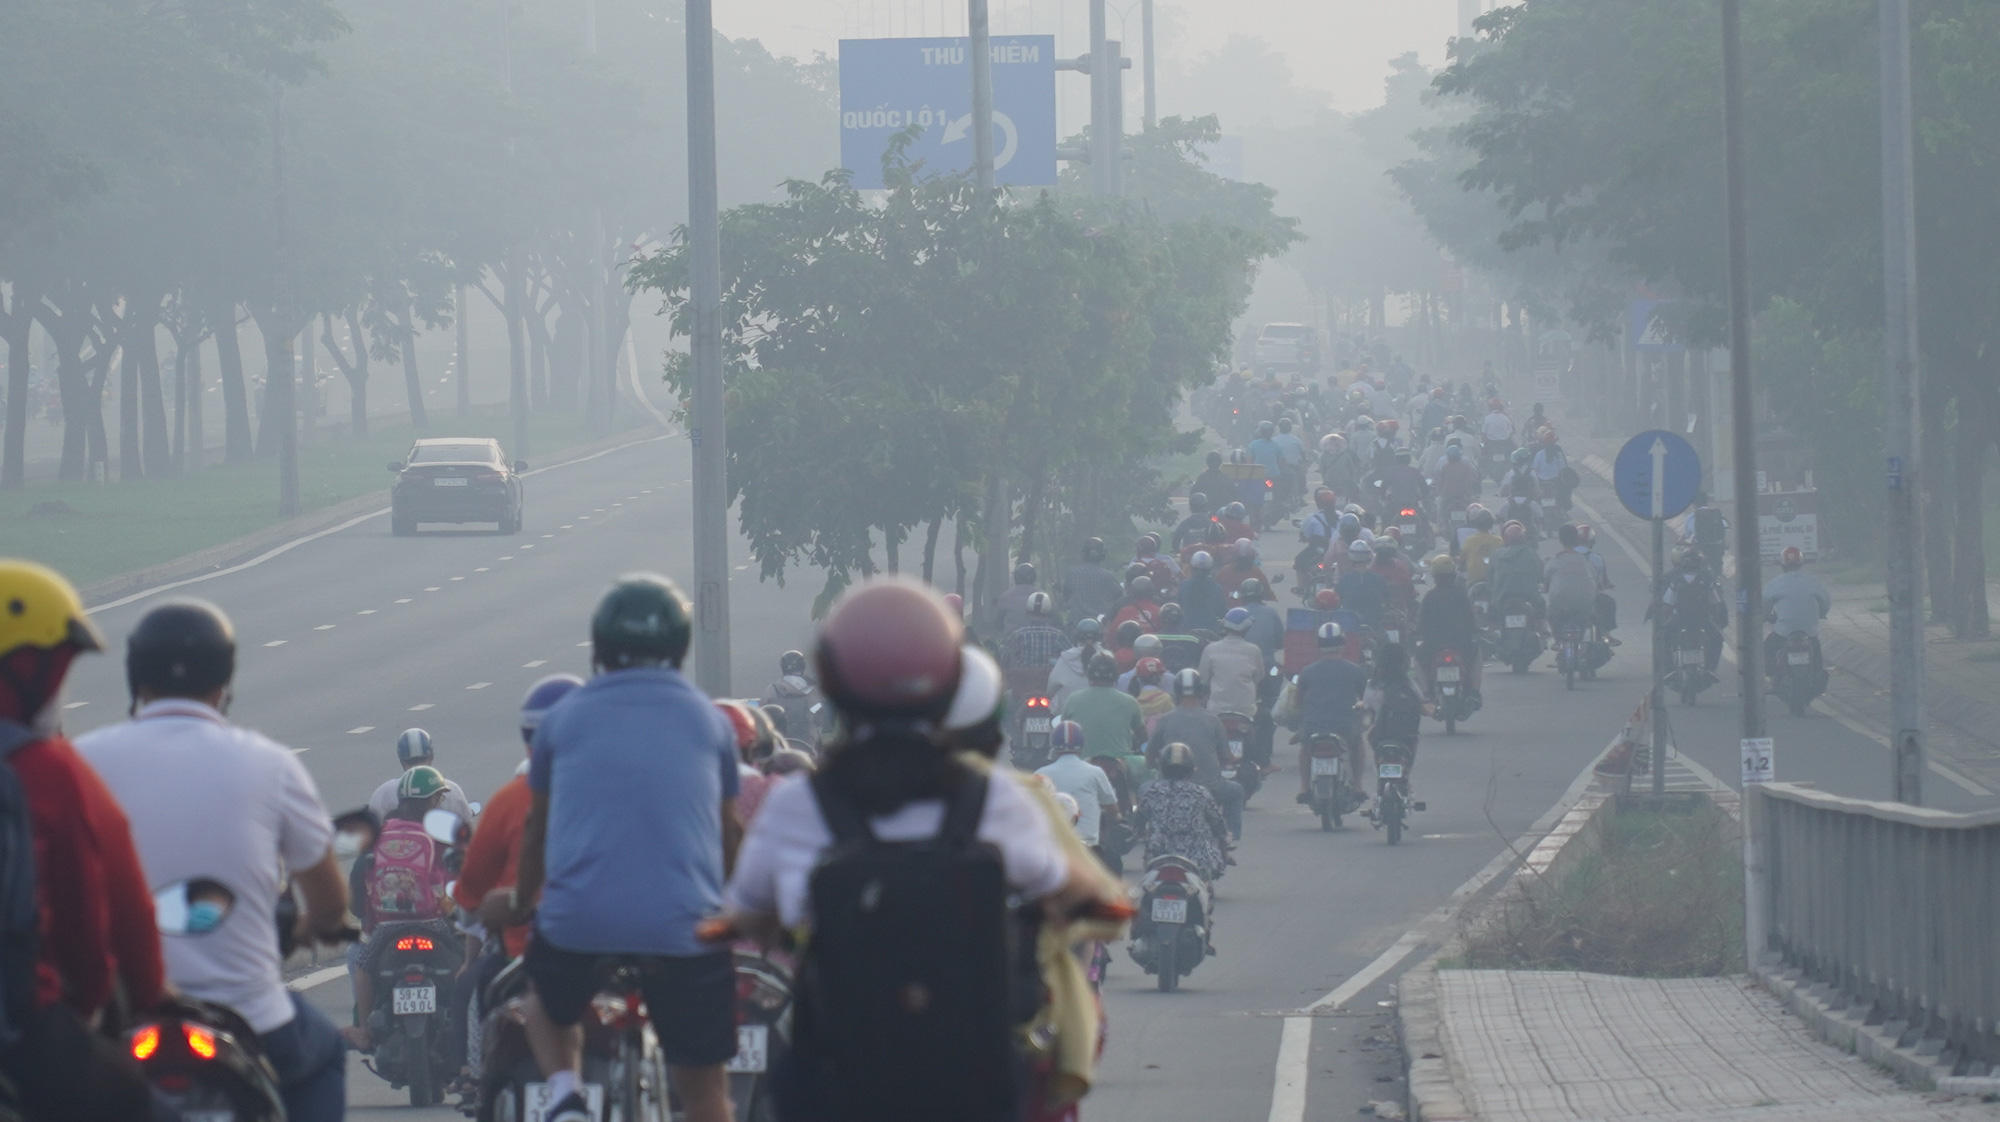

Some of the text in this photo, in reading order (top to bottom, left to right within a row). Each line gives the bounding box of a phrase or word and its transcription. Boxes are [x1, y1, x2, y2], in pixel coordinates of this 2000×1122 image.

[921, 39, 1039, 65] THỦ HIÊM
[843, 102, 901, 130] QUỐC
[936, 109, 947, 126] 1
[1744, 757, 1770, 772] 1,2
[399, 988, 429, 1000] 59-K2
